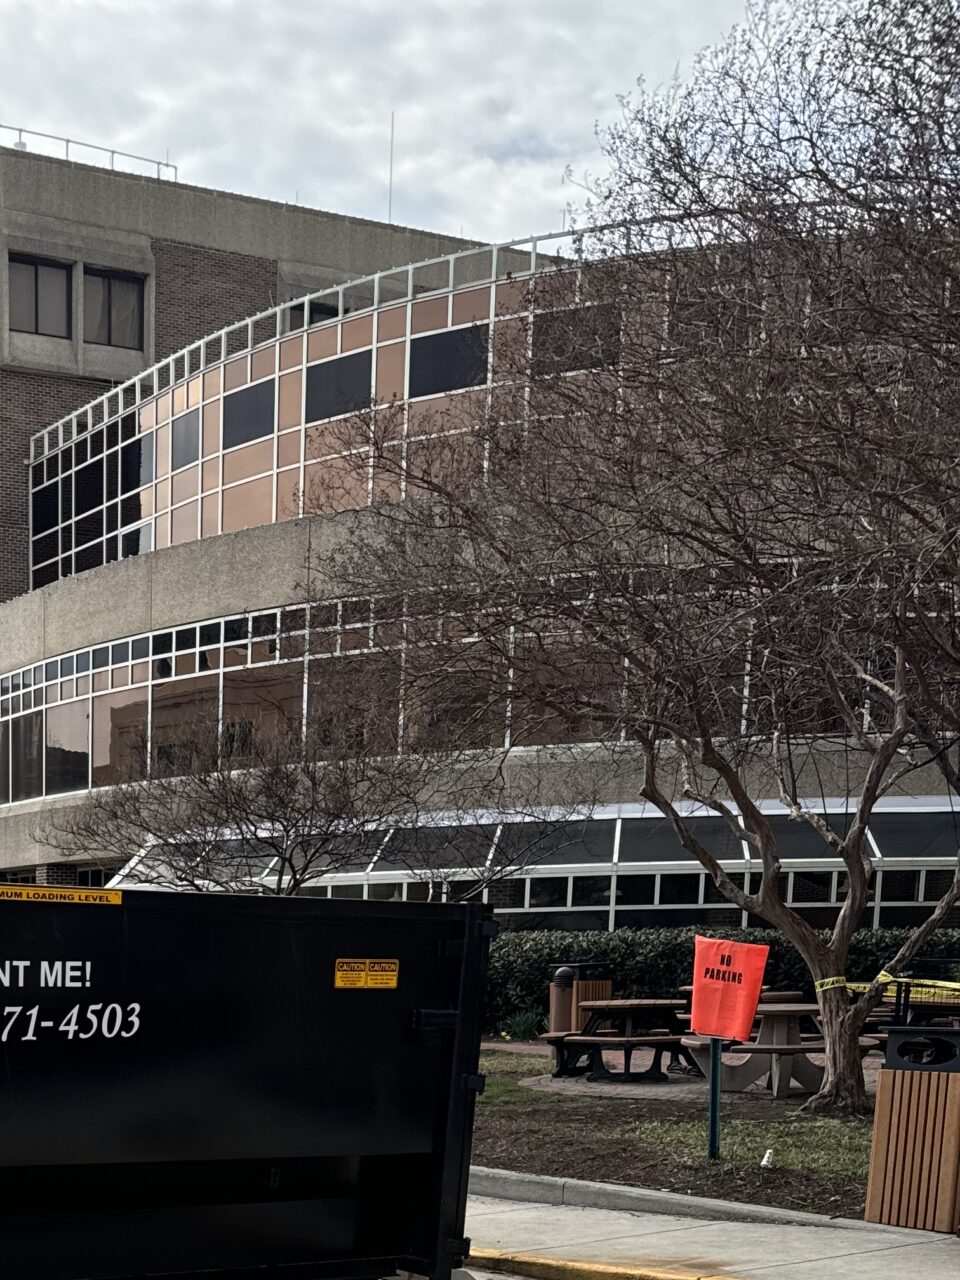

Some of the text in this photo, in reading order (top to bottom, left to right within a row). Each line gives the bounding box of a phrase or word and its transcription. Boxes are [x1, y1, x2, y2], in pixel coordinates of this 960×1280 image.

[26, 892, 75, 902] LOADING
[78, 894, 111, 903] LEVEL
[720, 954, 732, 966] NO
[338, 963, 365, 971] CAUTION
[369, 963, 397, 971] CAUTION
[40, 961, 92, 987] ME!
[704, 967, 743, 985] PARKING
